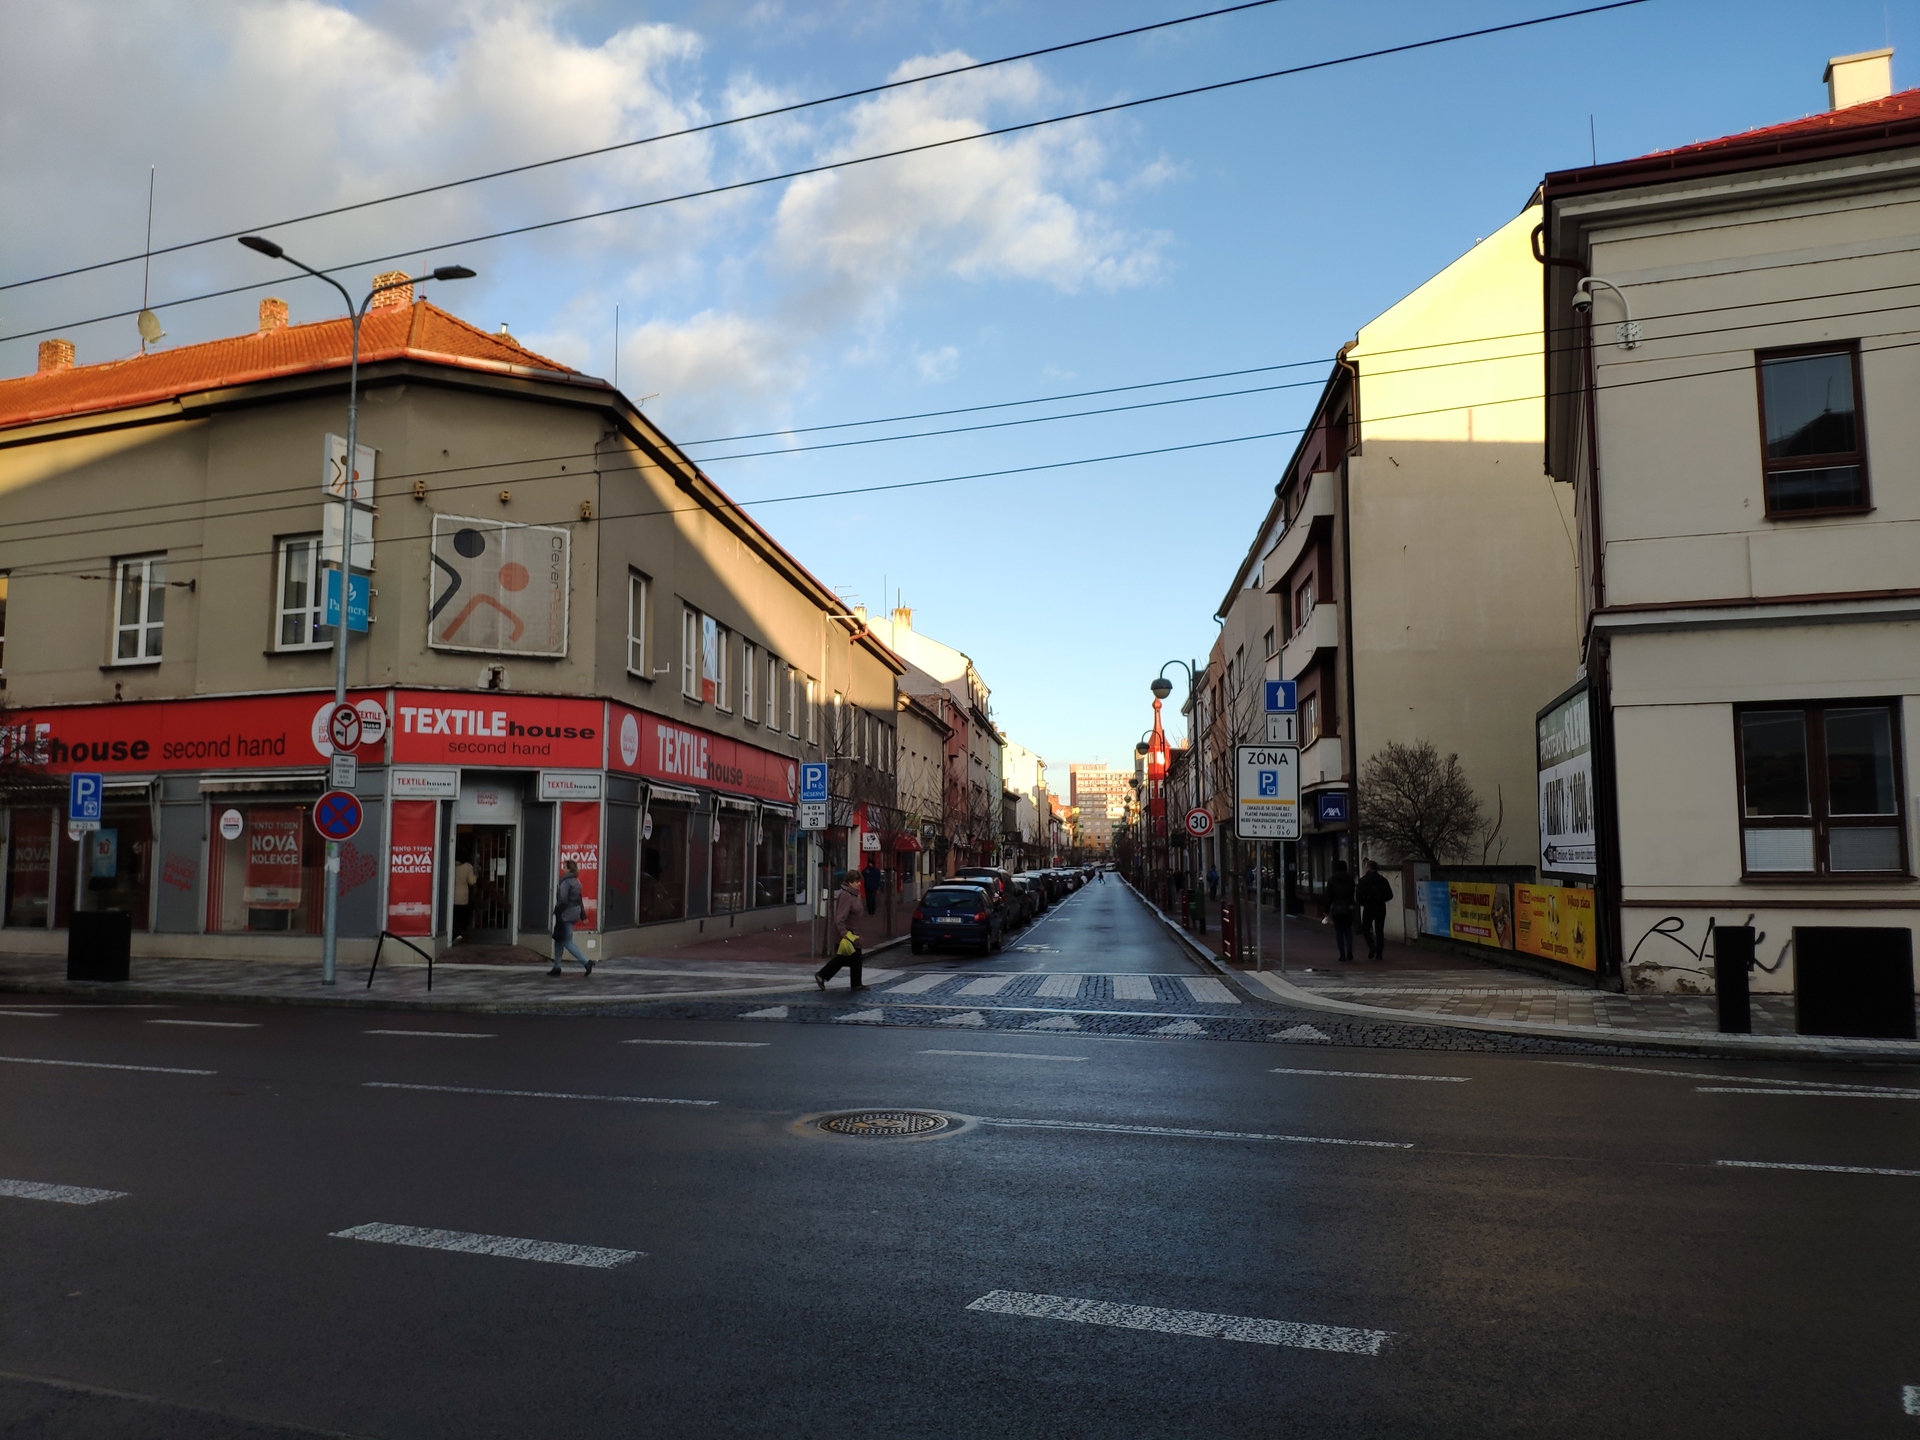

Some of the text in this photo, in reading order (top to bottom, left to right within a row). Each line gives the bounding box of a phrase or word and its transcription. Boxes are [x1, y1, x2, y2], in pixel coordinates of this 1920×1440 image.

[329, 598, 367, 616] Paners
[163, 735, 231, 760] second
[237, 733, 285, 757] hand
[448, 741, 551, 756] second hand
[1248, 749, 1289, 765] ZÓNA
[1323, 807, 1341, 817] AXA
[1191, 816, 1208, 829] 30
[252, 830, 298, 851] NOVÁ
[251, 854, 298, 865] KOLEKCE
[392, 851, 432, 865] NOVÁ
[561, 849, 597, 862] NOVÁ
[391, 865, 432, 873] KOLEKCE
